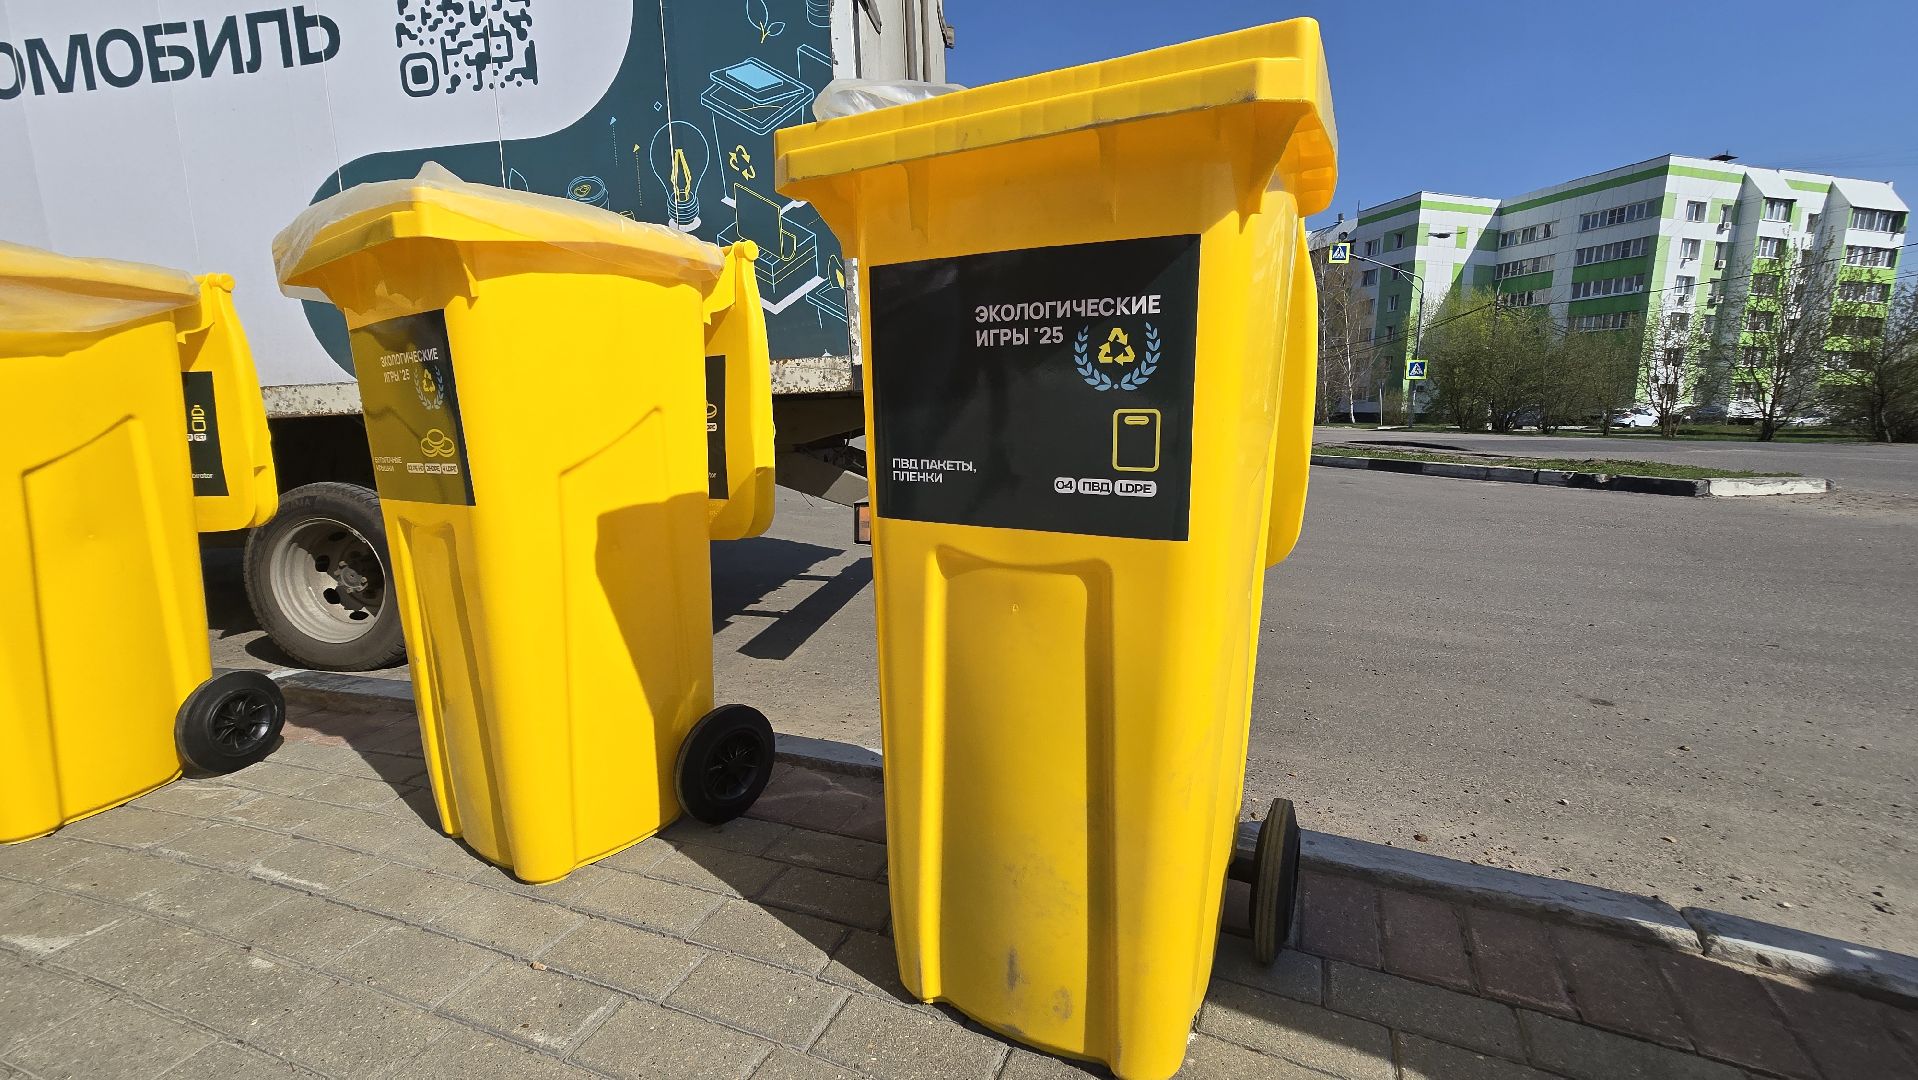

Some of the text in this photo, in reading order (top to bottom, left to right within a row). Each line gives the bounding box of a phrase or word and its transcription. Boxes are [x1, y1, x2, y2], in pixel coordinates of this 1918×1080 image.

[974, 294, 1161, 323] ЭКОЛОГИЧЕСКИЕ
[975, 327, 1029, 347] ИГРЫ
[380, 347, 439, 367] ЭКОЛОГИЧЕСКИЕ
[383, 370, 400, 383] ИГРЫ
[892, 457, 977, 474] ПВД ПАКЕТЫ,
[892, 470, 943, 484] ПЛЕНКИ
[1082, 481, 1111, 494] ПВД
[1119, 483, 1153, 495] LDPE
